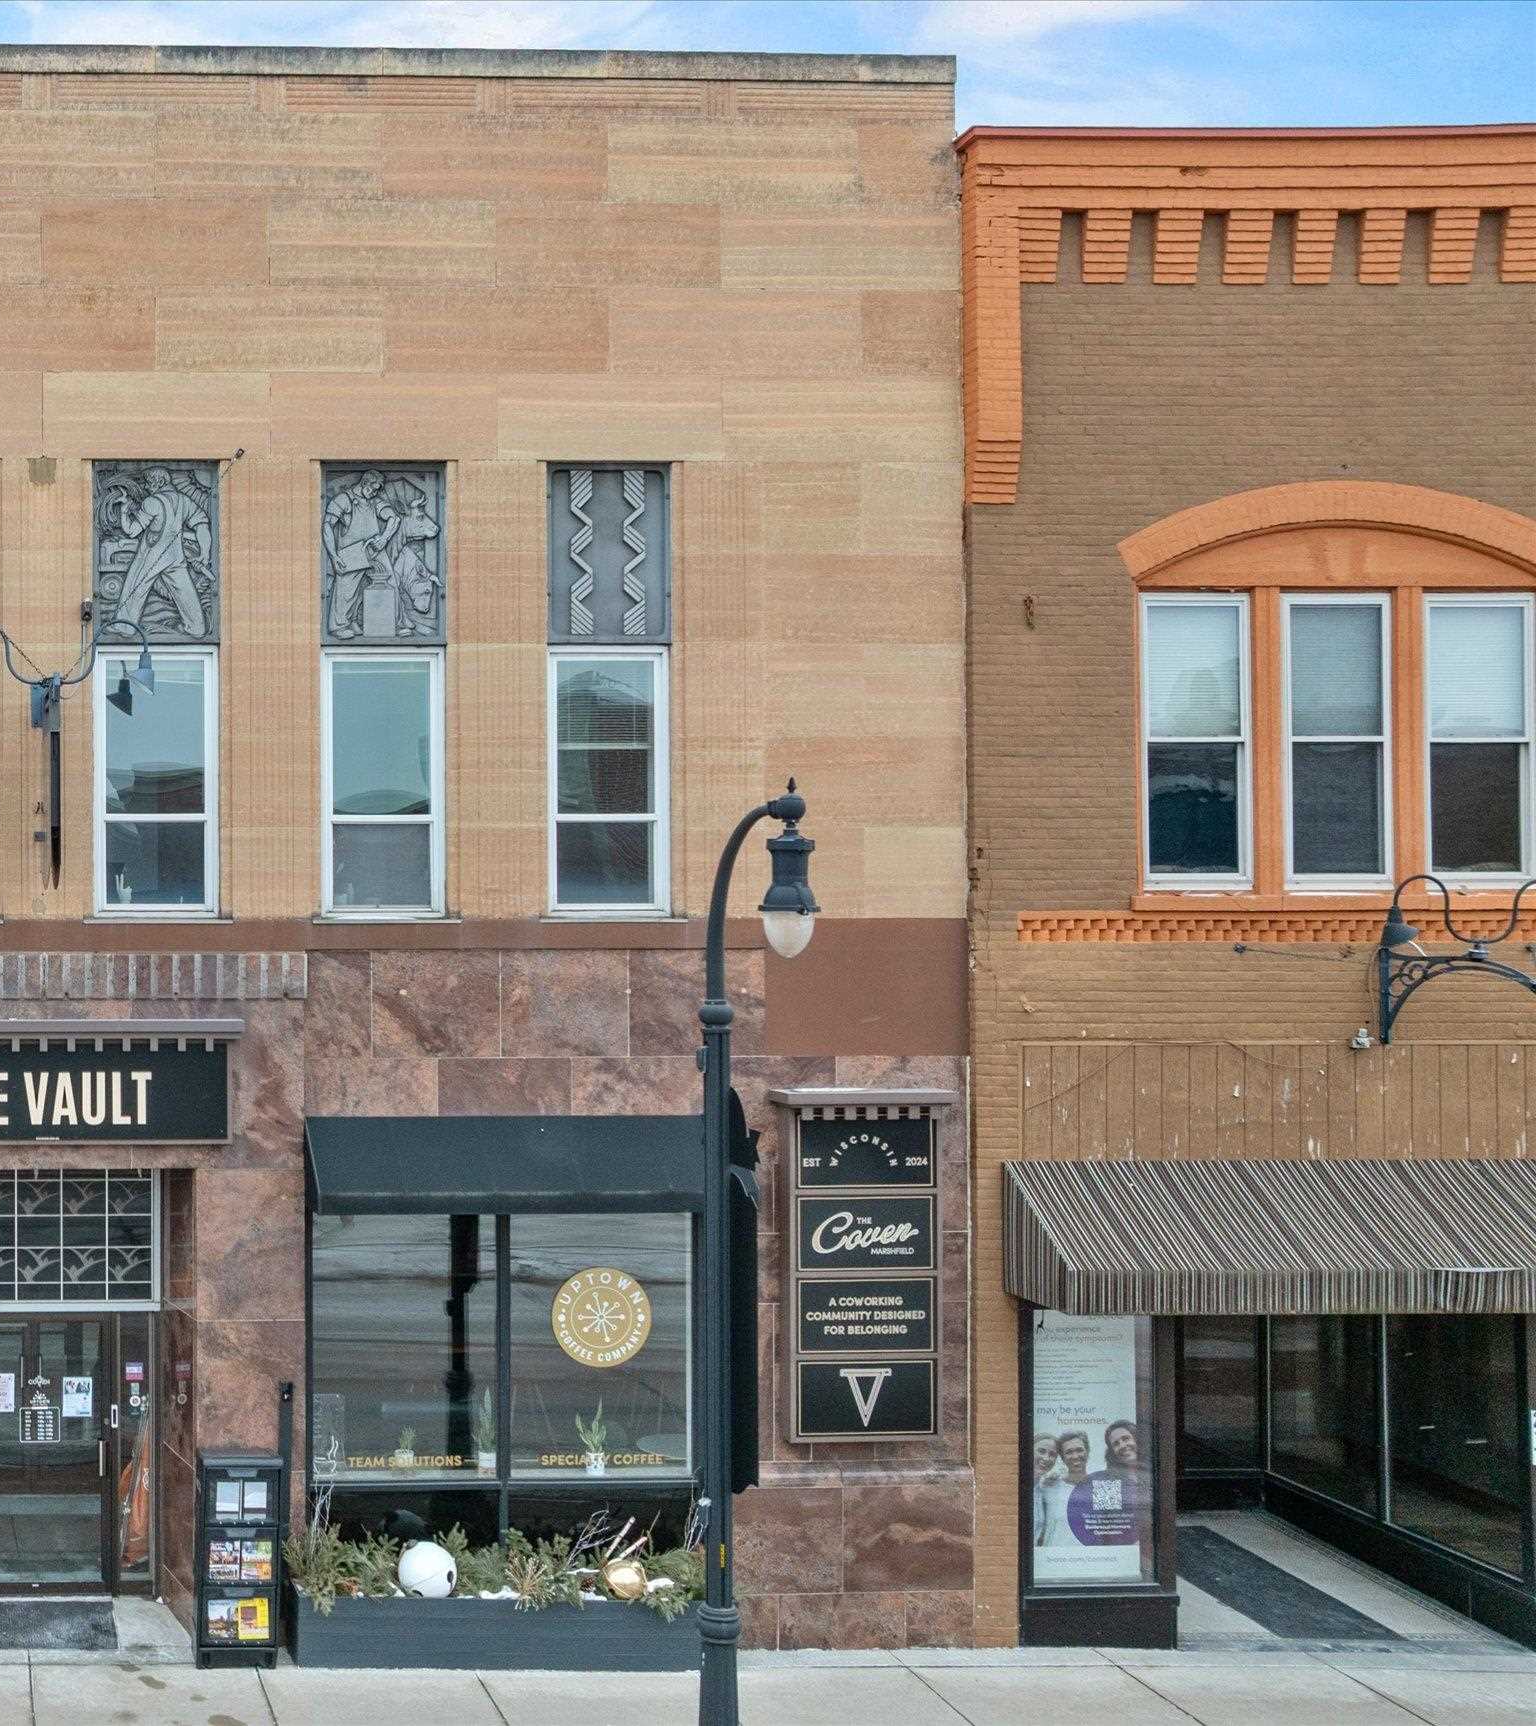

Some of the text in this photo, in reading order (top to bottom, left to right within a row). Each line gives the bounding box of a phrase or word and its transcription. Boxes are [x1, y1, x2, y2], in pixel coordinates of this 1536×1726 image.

[23, 1071, 152, 1125] VAULT
[829, 1133, 898, 1167] WISCONSIN
[803, 1157, 822, 1168] EST
[905, 1156, 928, 1167] 2024
[856, 1216, 872, 1225] THE
[811, 1211, 920, 1255] Coven
[870, 1247, 915, 1255] MARSHFIELD
[559, 1272, 644, 1305] UPTOWN
[828, 1296, 904, 1307] A COWORKING
[805, 1310, 926, 1321] COMMUNITY DESIGNED
[824, 1325, 908, 1335] FOR BELONGING
[560, 1328, 642, 1361] COFFEE COMPANY
[1037, 1404, 1097, 1417] may be your
[348, 1455, 462, 1467] TEAM SOLUTIONS
[541, 1454, 664, 1466] SPECIAY COFFEE
